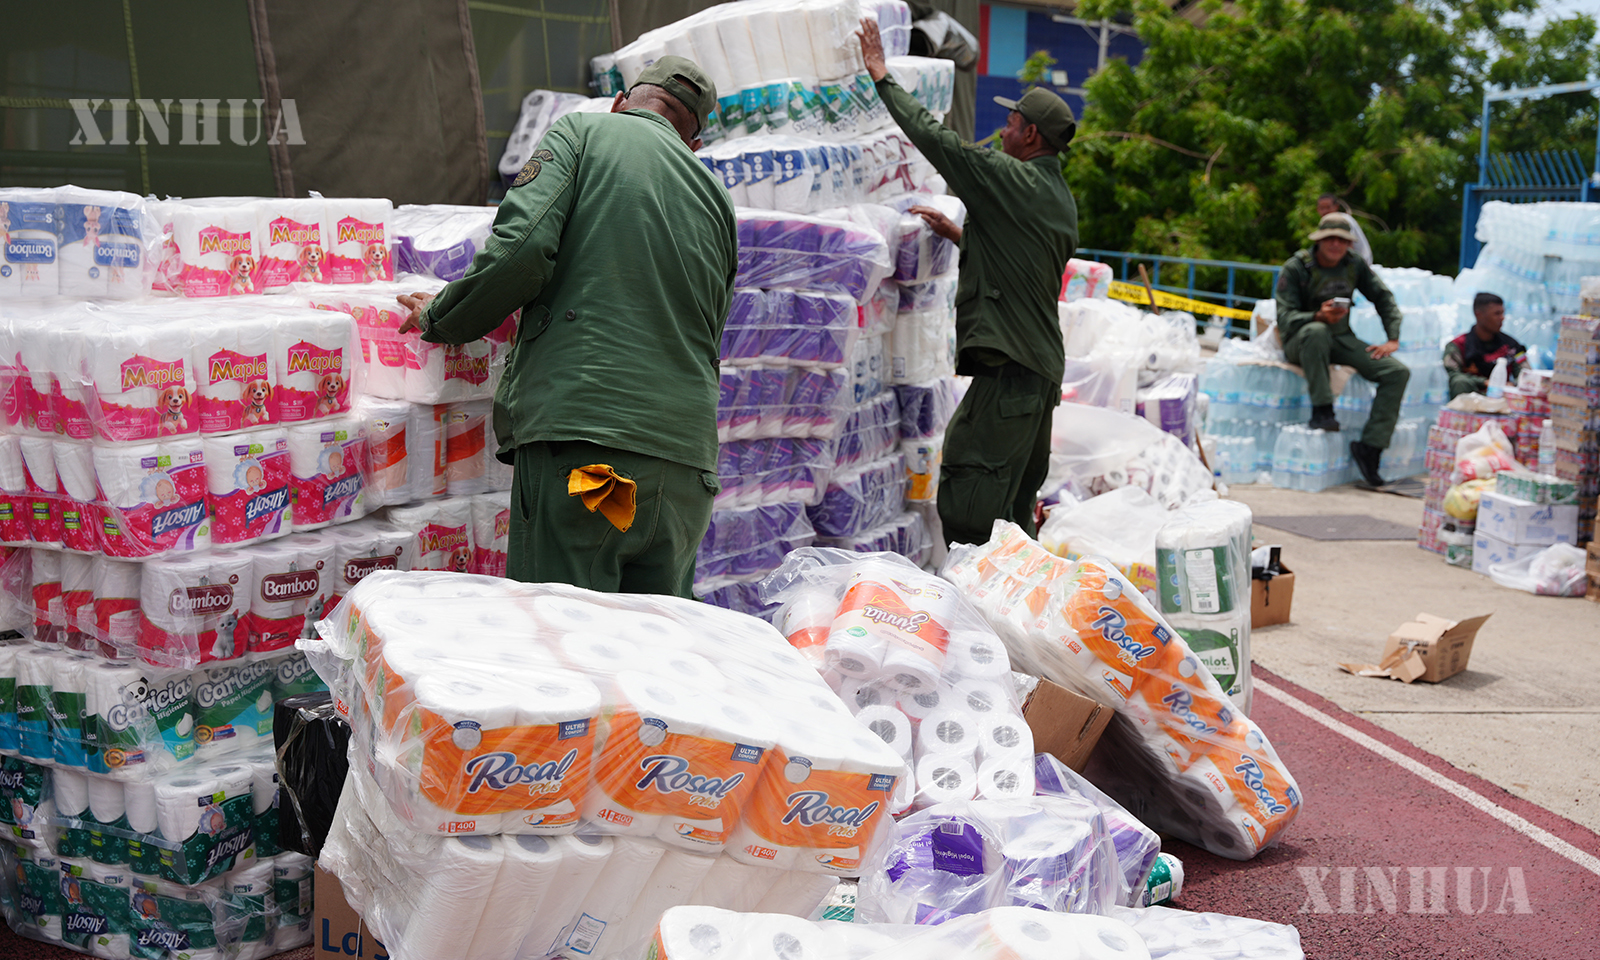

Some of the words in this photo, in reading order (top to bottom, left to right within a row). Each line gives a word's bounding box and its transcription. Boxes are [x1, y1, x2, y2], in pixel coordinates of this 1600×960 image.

[201, 233, 251, 255] Maple
[271, 224, 320, 244] Maple
[339, 224, 385, 244] Maple
[8, 244, 53, 257] Bamboo
[98, 247, 138, 261] Bamboo
[210, 356, 268, 383] Maple
[289, 350, 343, 374] Maple
[445, 355, 489, 377] Maple
[122, 363, 185, 389] Maple
[325, 475, 363, 502] Alisoft
[246, 488, 288, 519] Alisoft
[152, 502, 204, 534] Alisoft
[421, 528, 468, 553] Maple
[264, 578, 318, 596] Bamboo
[172, 593, 231, 611] Bamboo
[1091, 606, 1156, 660] Rosal
[1117, 649, 1137, 667] Plus
[197, 659, 271, 708] Caricias
[107, 675, 193, 733] Caricias
[156, 699, 189, 720] Higiénico
[220, 694, 240, 708] Papel
[1162, 682, 1218, 735] Rosal
[565, 722, 585, 731] ULTRA
[739, 747, 759, 756] ULTRA
[465, 748, 578, 793] Rosal
[636, 754, 745, 798] Rosal
[874, 777, 892, 785] ULTRA
[528, 781, 561, 797] Plus
[1234, 754, 1287, 815] Rosal
[689, 793, 721, 810] Plus
[781, 790, 879, 827] Rosal
[438, 821, 447, 832] 4
[456, 821, 475, 830] 400
[598, 808, 607, 819] 4
[615, 813, 632, 824] 400
[827, 823, 857, 839] Plus
[206, 828, 251, 867] Alisoft
[744, 844, 753, 855] 4
[761, 848, 776, 857] 400
[67, 914, 106, 933] Alisoft
[138, 929, 188, 950] Alisoft
[322, 918, 363, 958] La
